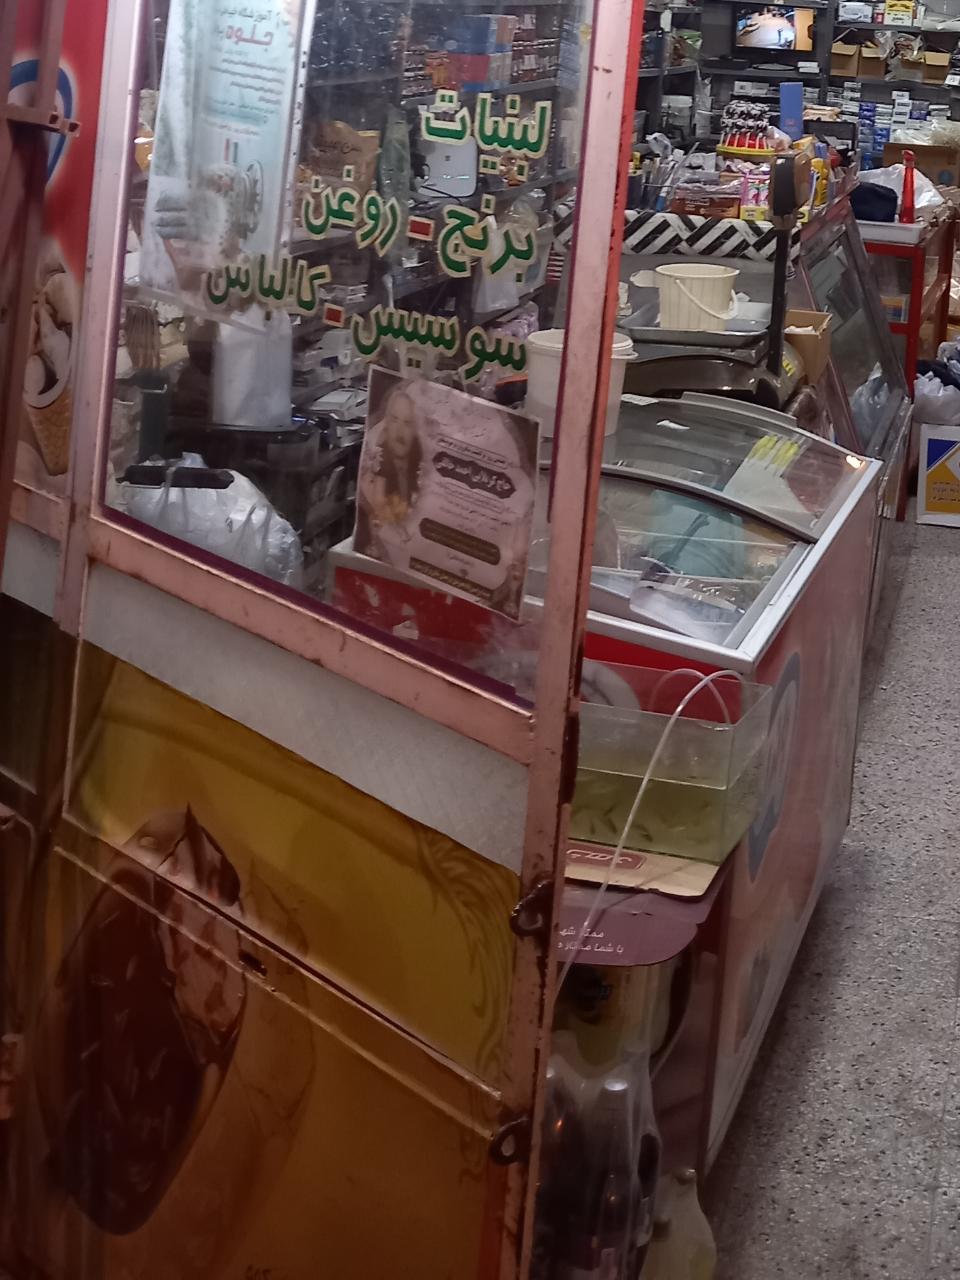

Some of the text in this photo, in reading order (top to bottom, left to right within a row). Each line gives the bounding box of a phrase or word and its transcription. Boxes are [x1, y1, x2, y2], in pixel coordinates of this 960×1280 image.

[420, 88, 554, 183] لبنیات
[302, 165, 400, 256] روغن
[439, 193, 538, 283] برنج
[205, 254, 332, 320] کالباس
[351, 304, 529, 382] سوسیس
